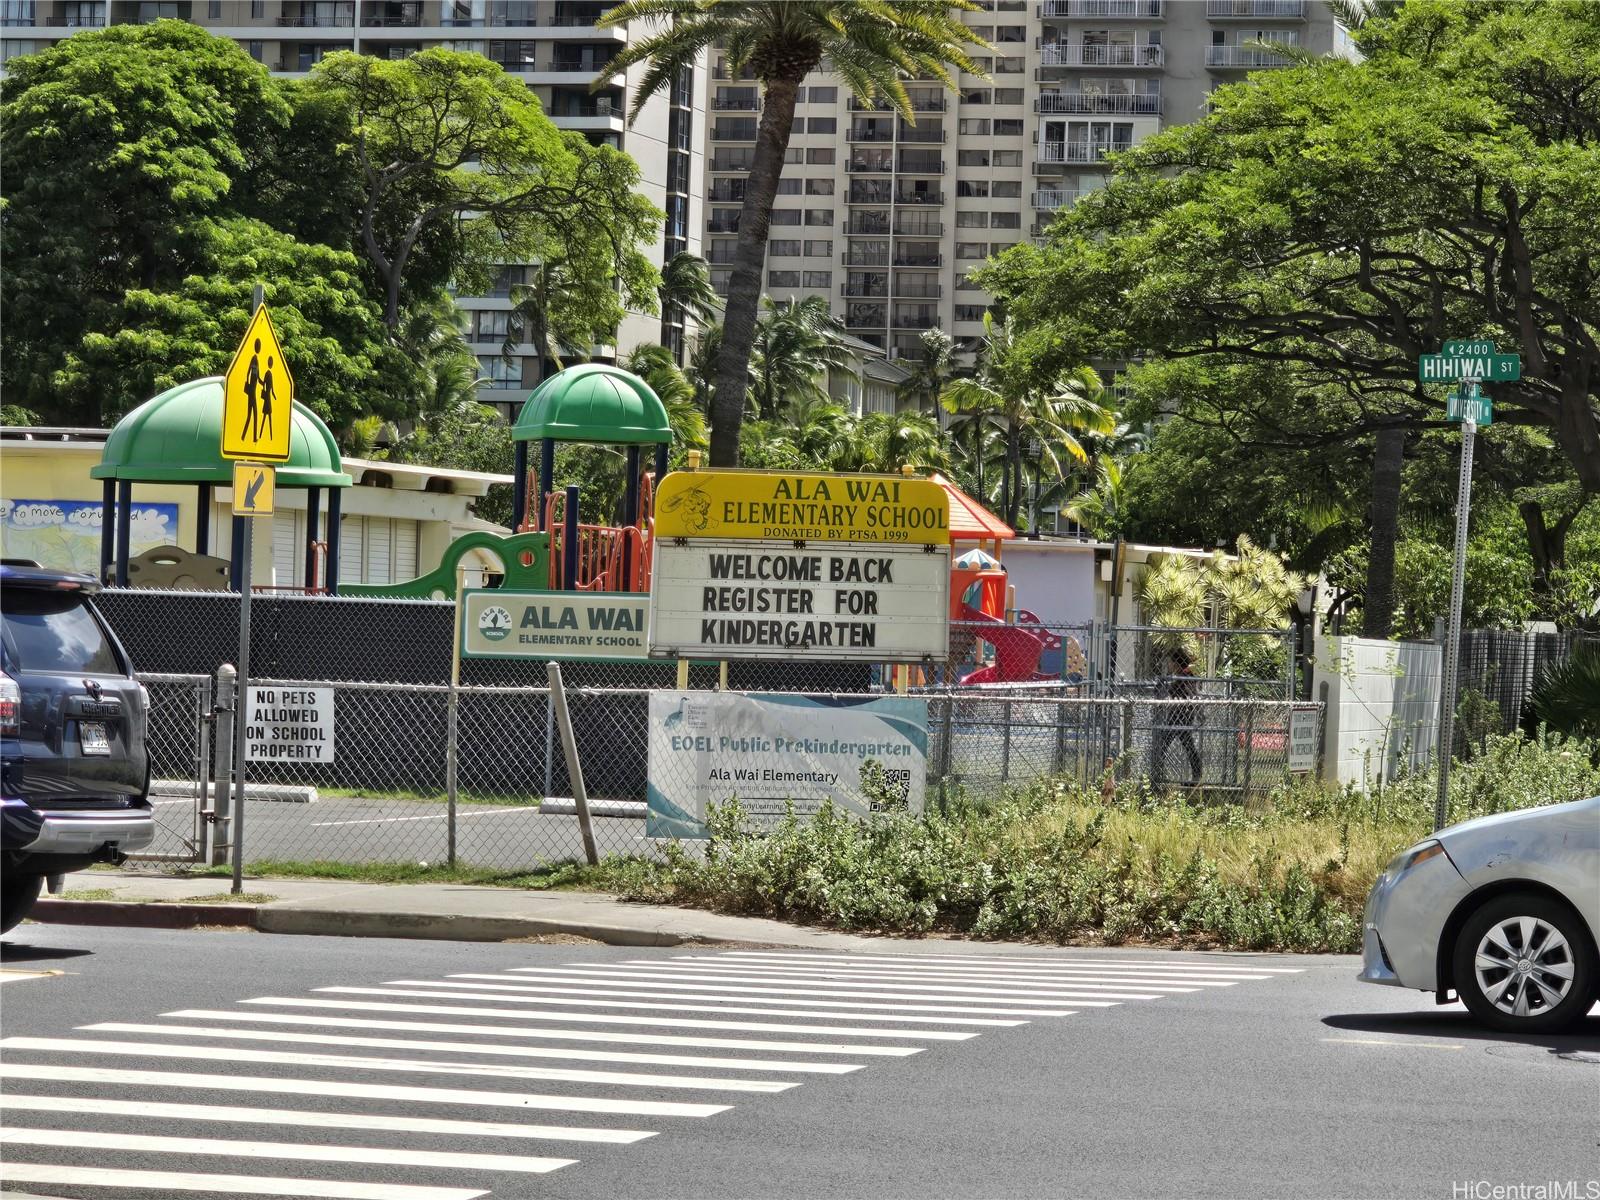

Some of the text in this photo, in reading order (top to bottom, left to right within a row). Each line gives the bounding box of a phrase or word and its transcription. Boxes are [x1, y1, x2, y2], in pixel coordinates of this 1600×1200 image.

[1458, 344, 1488, 355] 2400
[1501, 362, 1513, 373] ST
[772, 478, 901, 503] ALA WAI
[14, 507, 26, 519] to
[31, 508, 64, 518] move
[723, 501, 948, 529] ELEMENTARY SCHOOL
[763, 527, 909, 541] DONATED BY PTSA 1999
[709, 553, 893, 583] WELCOME BACK
[703, 586, 878, 615] REGISTER FOR
[481, 607, 512, 624] ALA WAI
[519, 605, 644, 632] ALA WAI
[518, 634, 642, 647] ELEMENTARY SCHOOL
[701, 618, 876, 647] KINDERGARTEN
[256, 690, 316, 705] NO PETS
[254, 708, 319, 723] ALLOWED
[246, 726, 326, 741] ON SCHOOL
[250, 743, 322, 759] PROPERTY
[671, 735, 911, 758] EOEL Public Prekindergarten
[708, 769, 839, 785] Ala Wai Elementary
